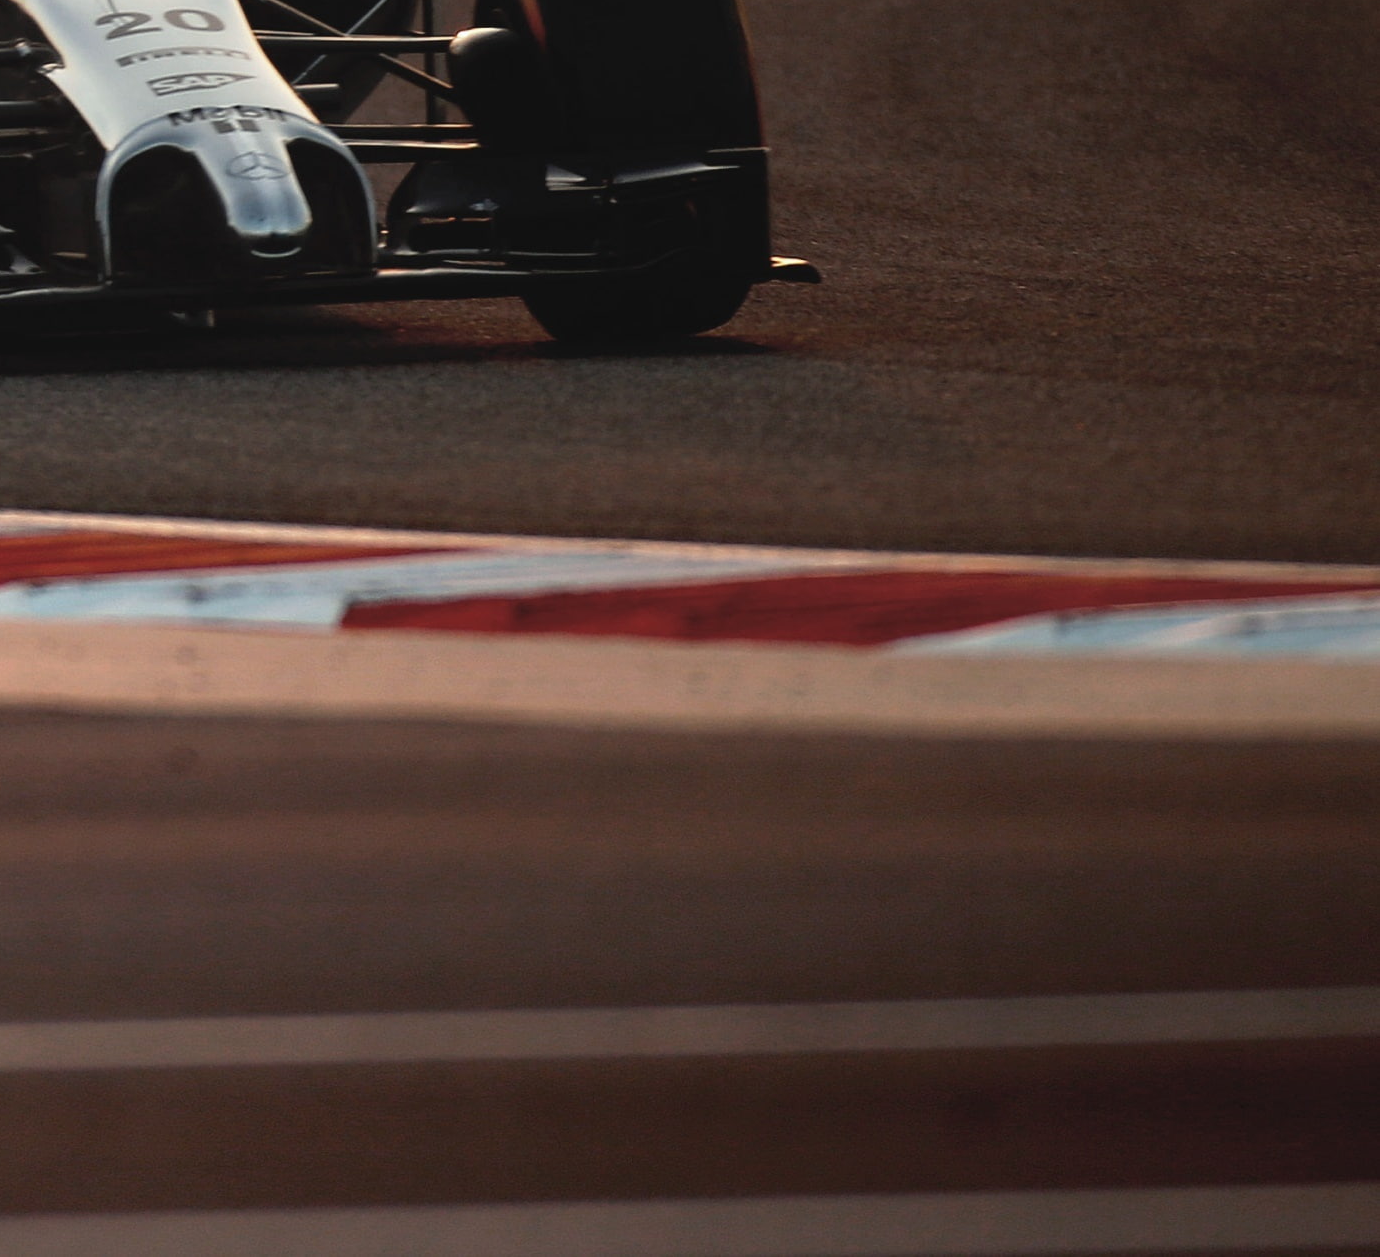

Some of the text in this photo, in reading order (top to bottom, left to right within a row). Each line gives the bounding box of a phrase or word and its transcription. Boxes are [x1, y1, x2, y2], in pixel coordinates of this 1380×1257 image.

[96, 9, 225, 40] 20
[150, 74, 237, 94] SAP
[167, 105, 287, 127] Mobil
